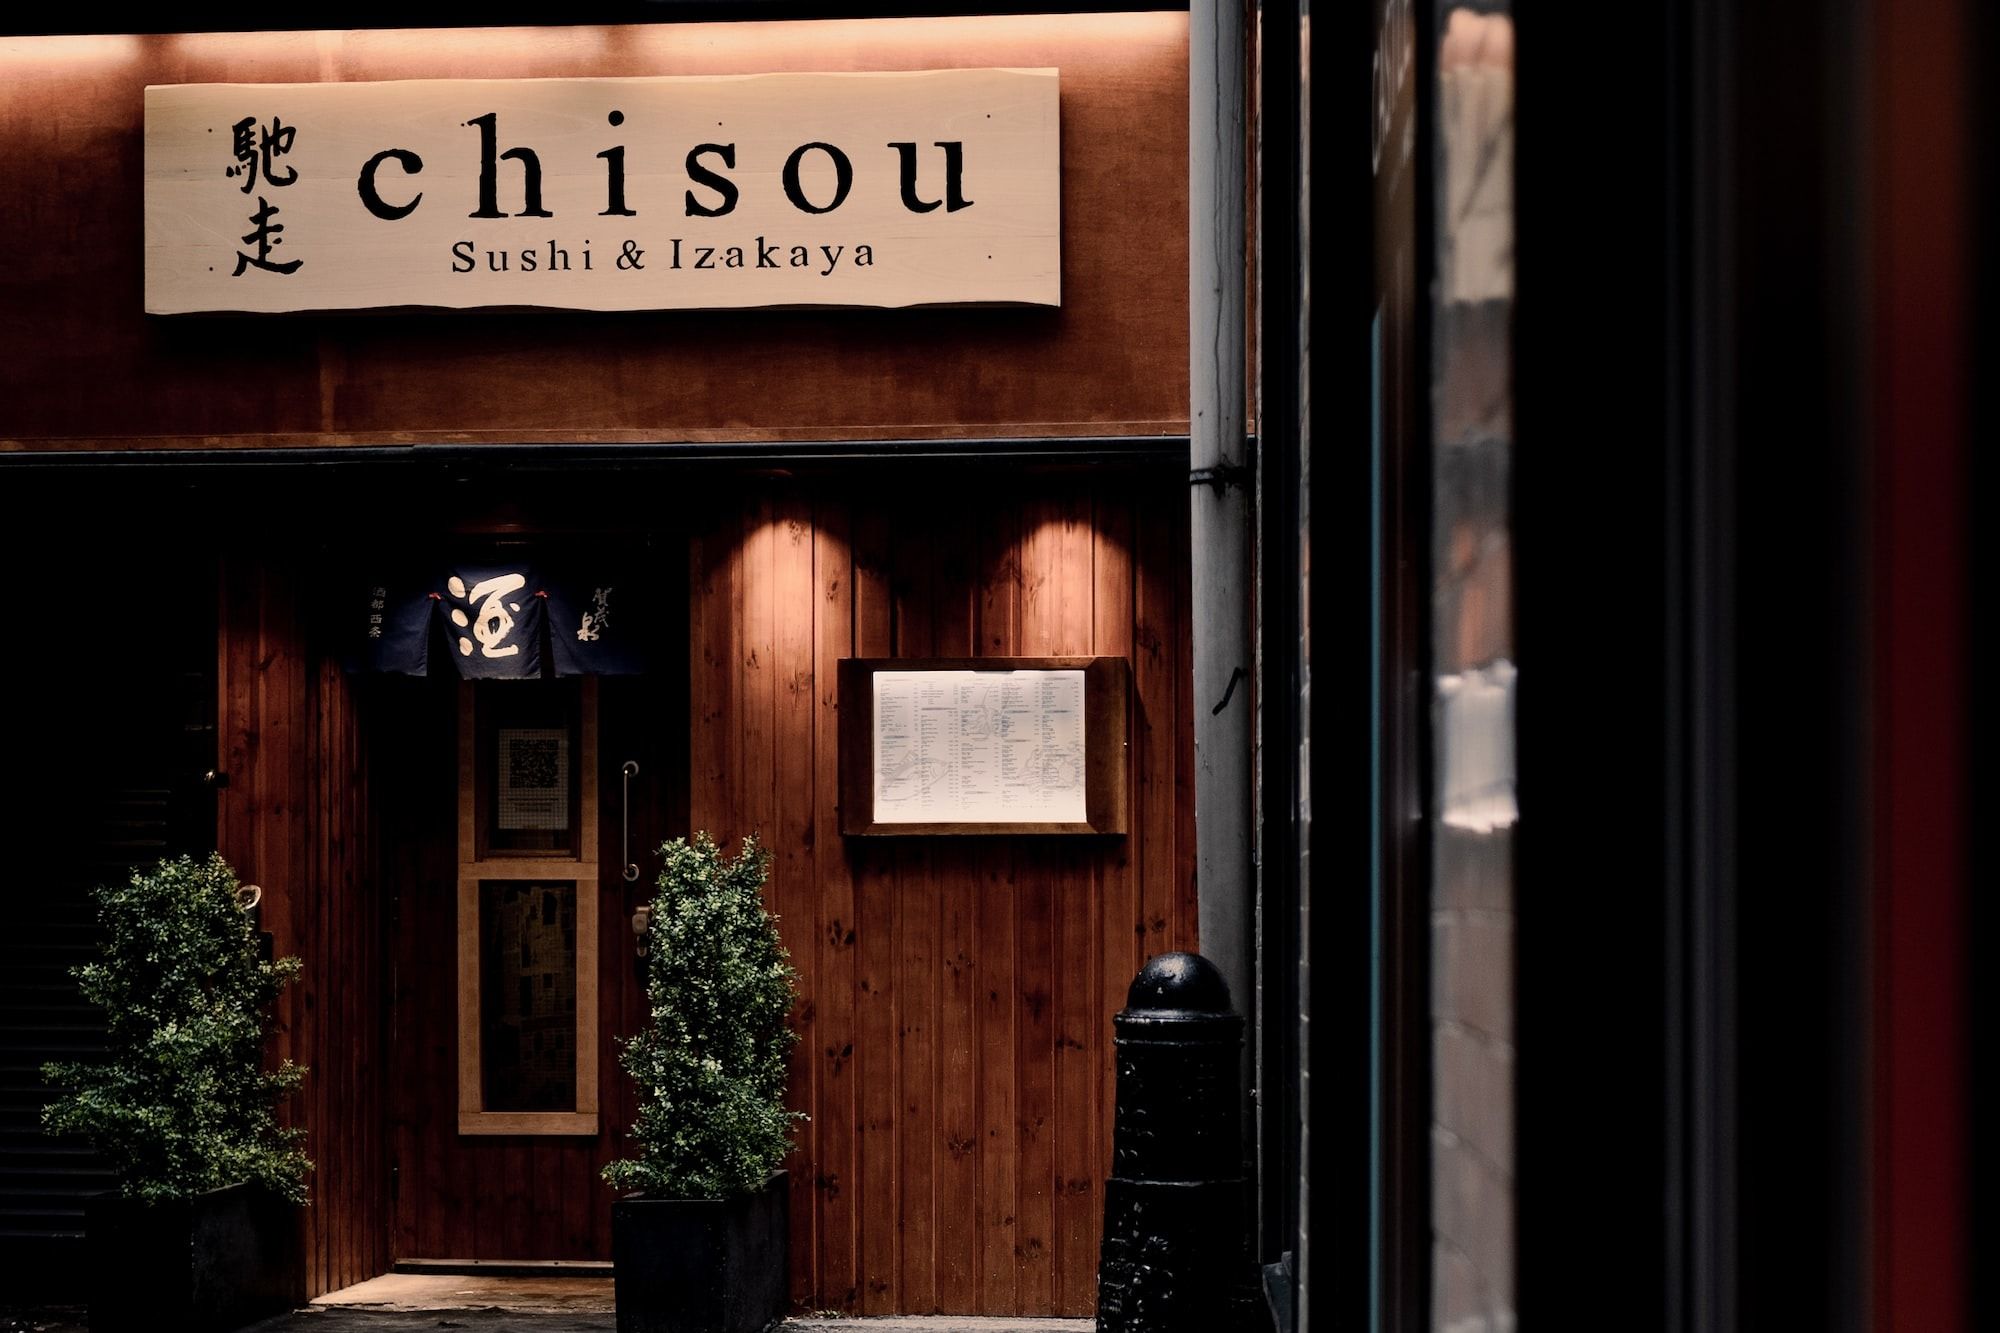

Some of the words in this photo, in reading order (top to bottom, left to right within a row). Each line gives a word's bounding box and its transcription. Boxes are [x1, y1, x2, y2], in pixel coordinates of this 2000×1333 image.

[226, 117, 303, 277] 馳走
[358, 111, 974, 220] chisou
[453, 240, 593, 273] Sushi
[617, 240, 646, 271] &
[671, 238, 874, 277] Izakaya
[448, 574, 526, 659] 酒
